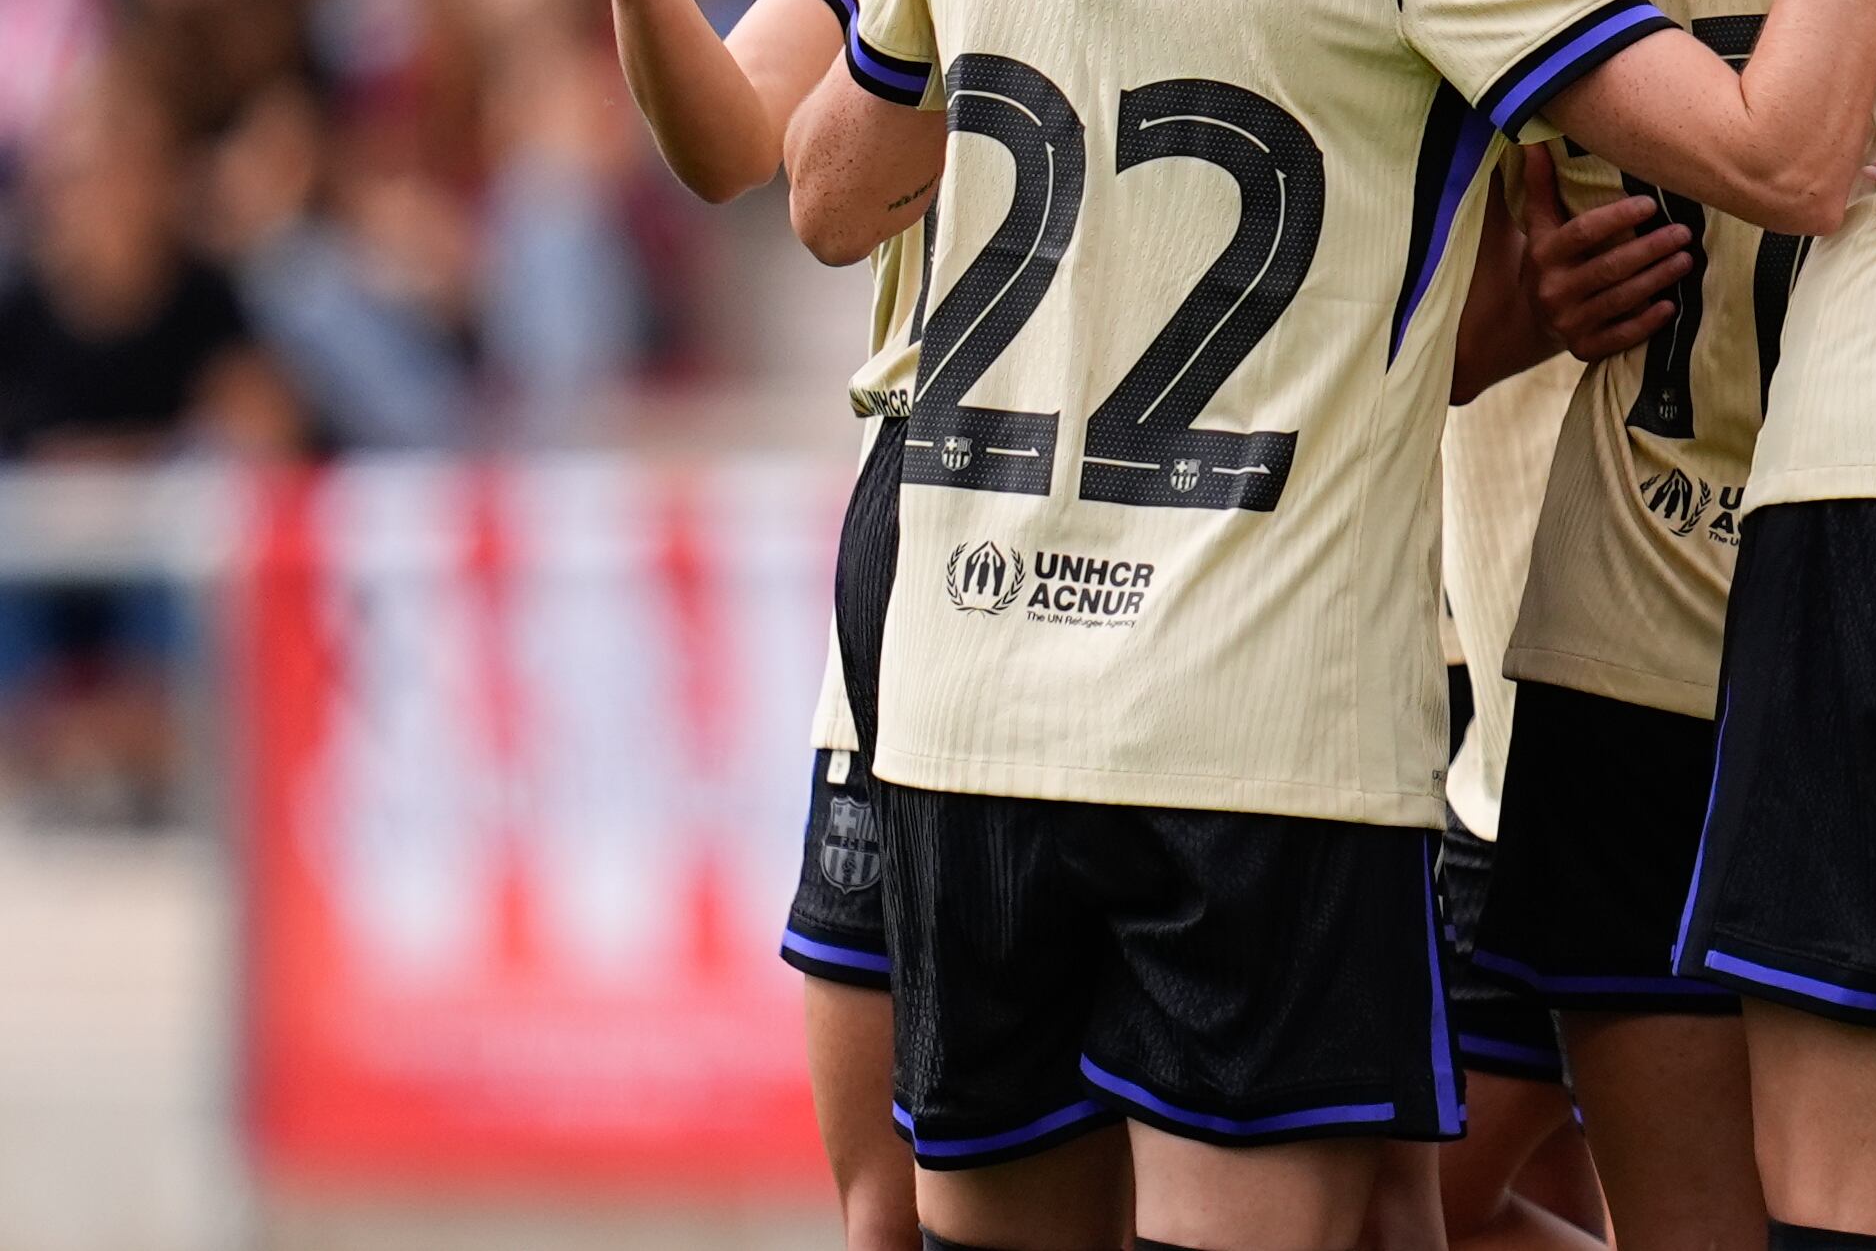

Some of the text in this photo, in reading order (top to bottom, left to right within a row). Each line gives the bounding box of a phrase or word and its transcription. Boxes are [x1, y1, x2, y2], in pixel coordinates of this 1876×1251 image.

[901, 52, 1325, 513] 22
[1034, 551, 1155, 588] UNHCR
[1027, 582, 1145, 616] ACNUR
[1026, 610, 1045, 622] The
[1047, 614, 1063, 624] UN
[1065, 615, 1104, 629] Refugee
